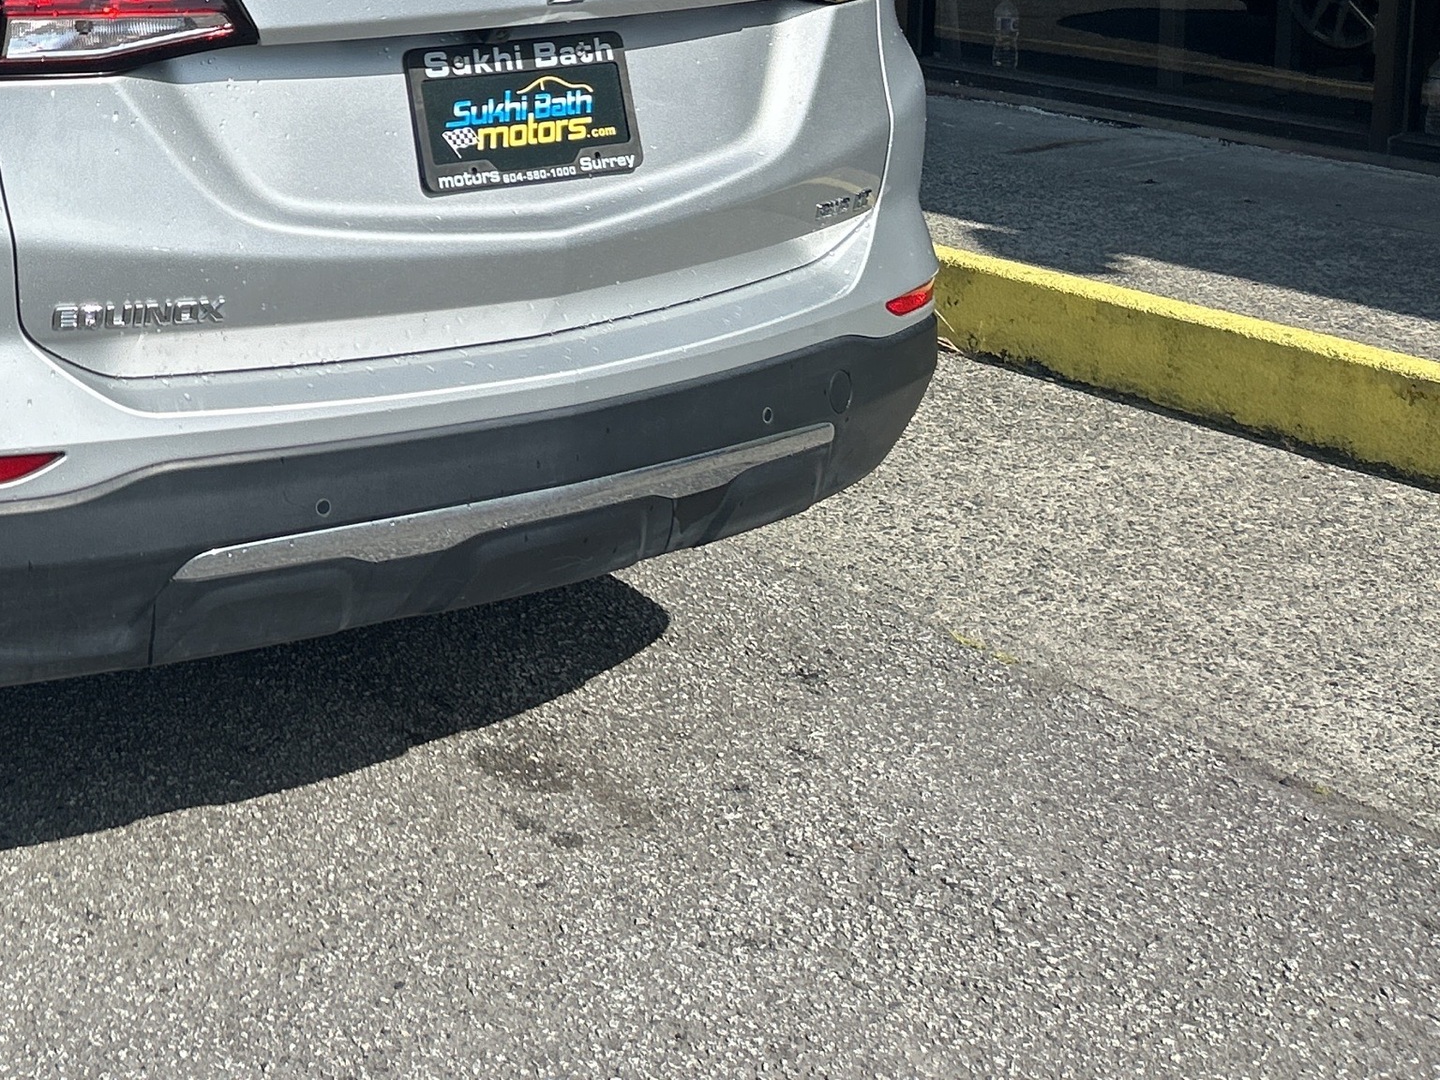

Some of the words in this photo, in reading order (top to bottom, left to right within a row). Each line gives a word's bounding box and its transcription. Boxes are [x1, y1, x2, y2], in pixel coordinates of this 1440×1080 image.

[533, 37, 615, 69] Bath
[445, 90, 528, 128] Sukhi
[534, 90, 593, 119] Bath
[438, 169, 501, 189] motors
[579, 154, 636, 172] Surrey
[52, 295, 226, 331] EQUINOX
